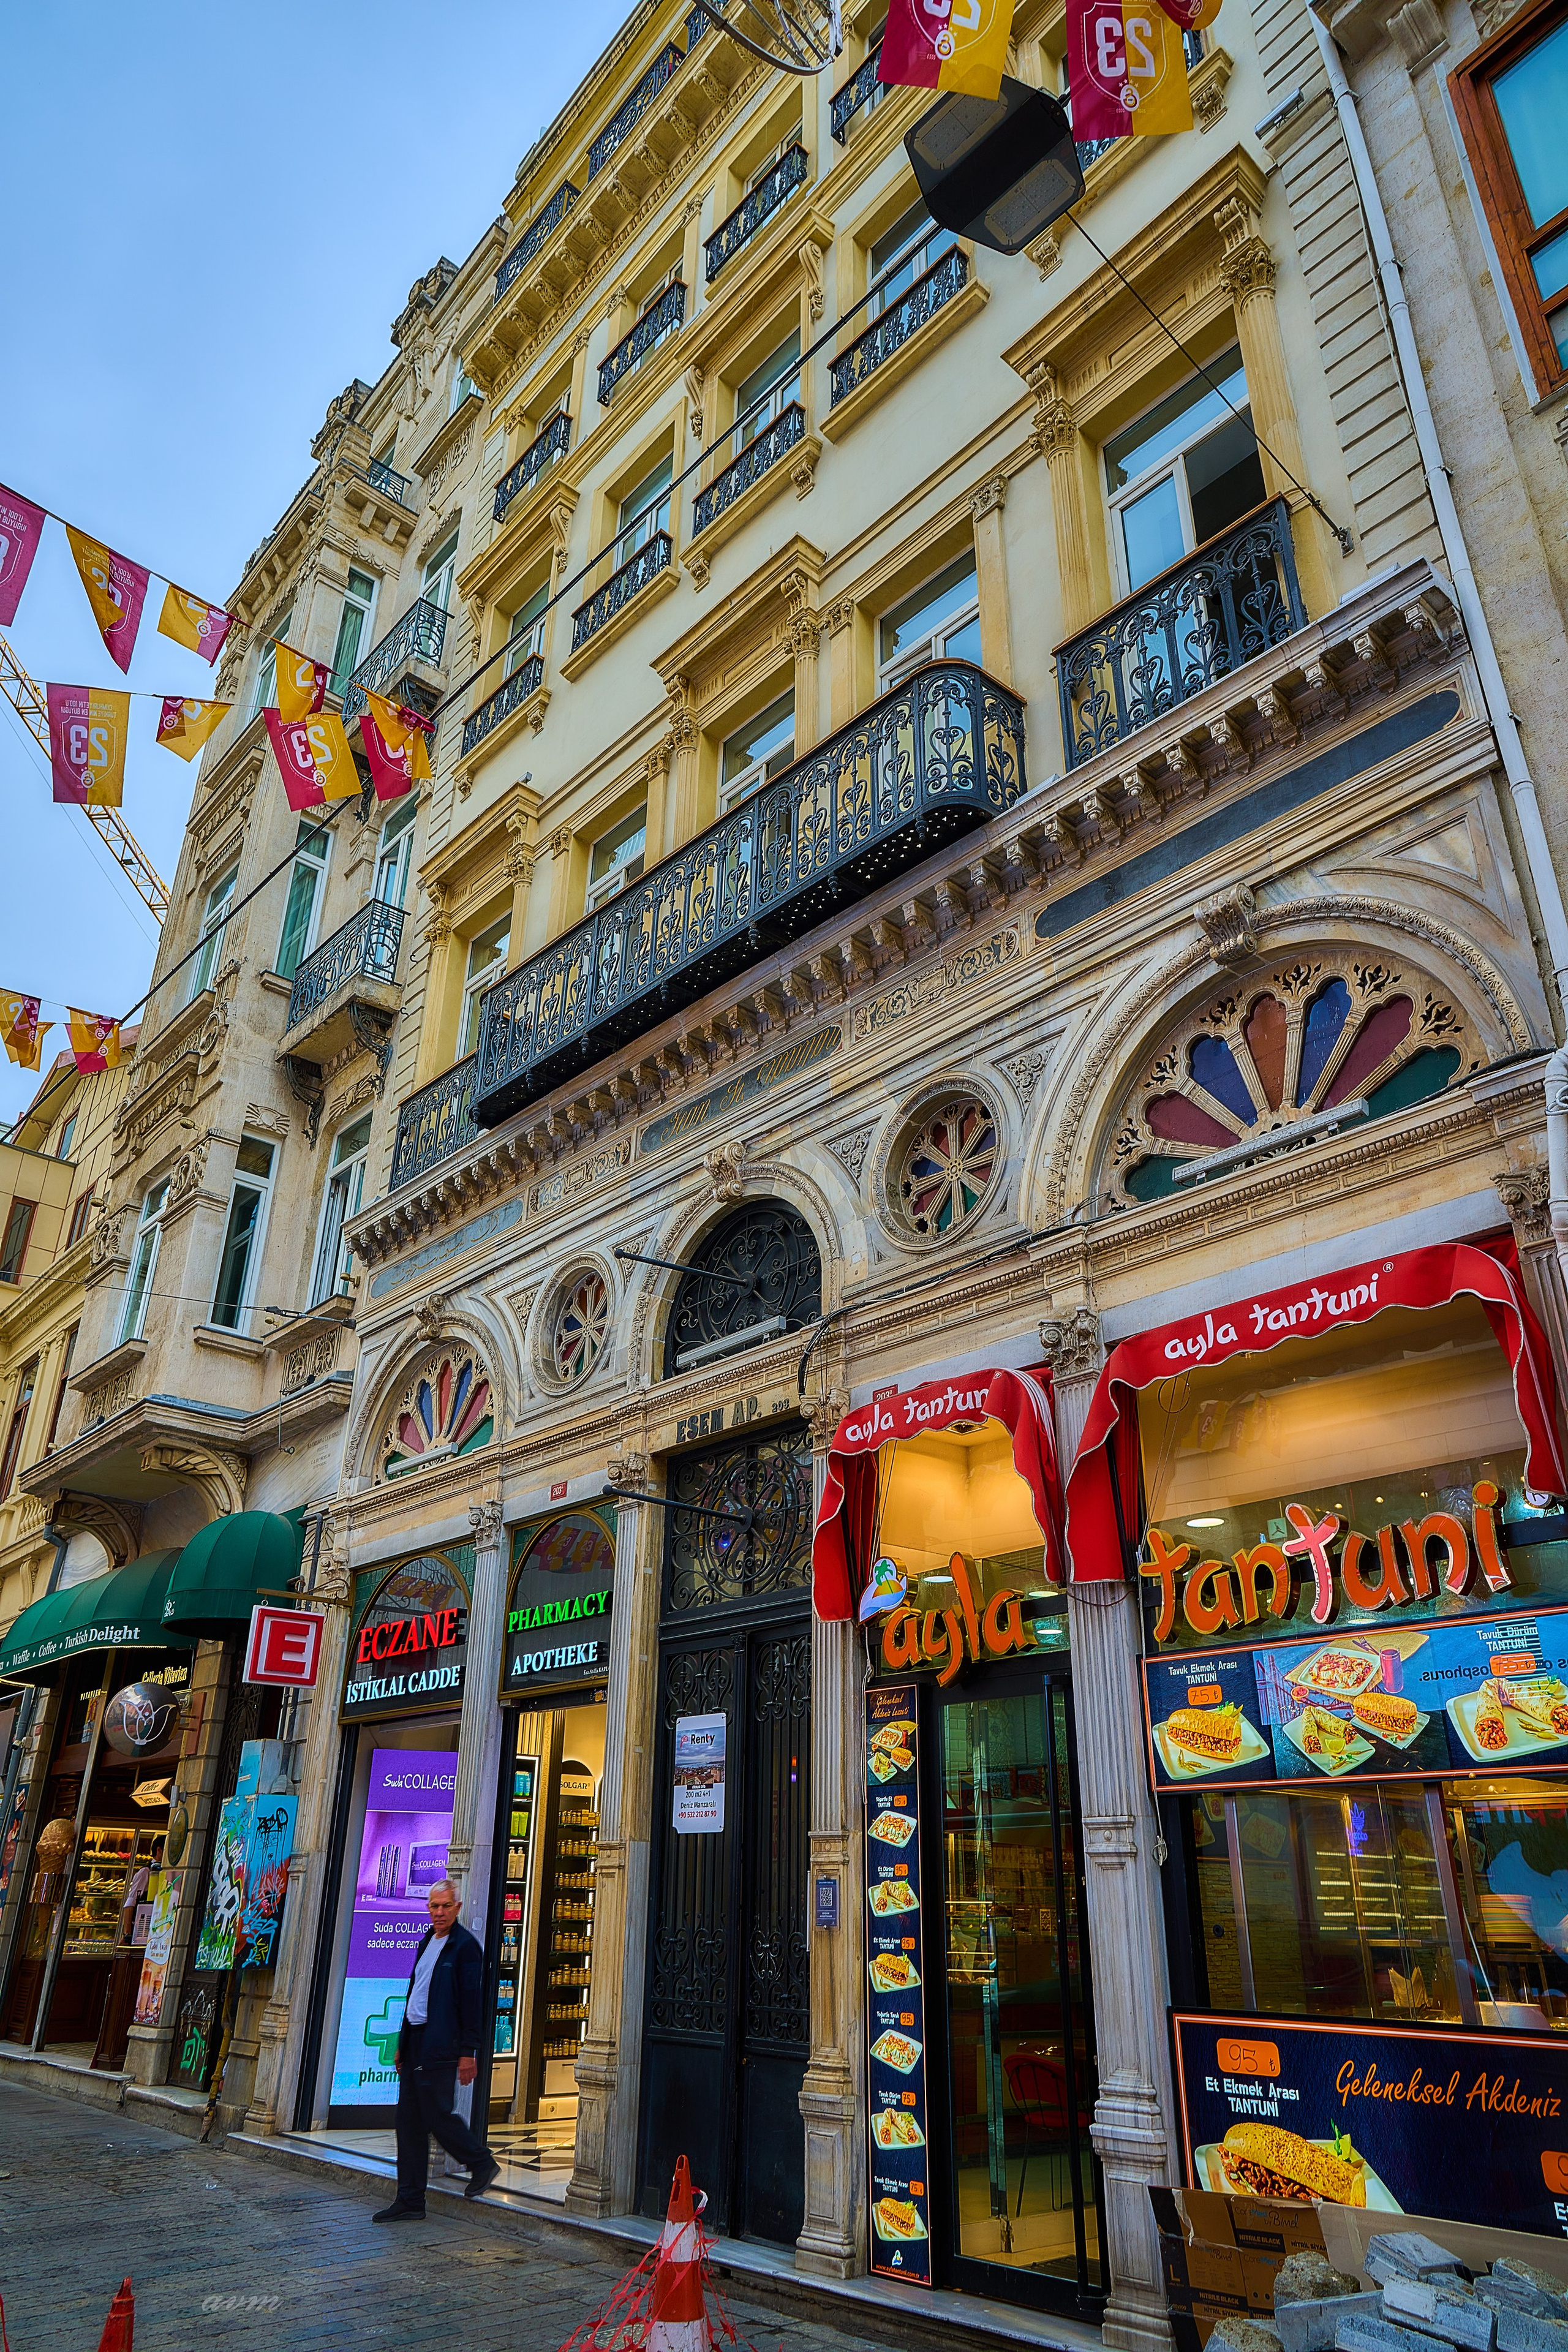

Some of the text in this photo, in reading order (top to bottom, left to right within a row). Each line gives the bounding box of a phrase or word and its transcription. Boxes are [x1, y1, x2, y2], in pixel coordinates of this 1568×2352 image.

[1164, 1273, 1379, 1360] ayla tantuni
[676, 1396, 790, 1443] ESEN AP. 203
[846, 1386, 989, 1443] ayla tantun
[1139, 1480, 1511, 1644] tantuni
[508, 1590, 608, 1633] PHARMACY
[882, 1551, 1024, 1687] ayla
[12, 1649, 30, 1666] Waffle
[39, 1642, 57, 1657] Coffee
[64, 1629, 88, 1649] Turkish
[88, 1625, 141, 1643] Delight
[264, 1620, 310, 1675] E
[356, 1608, 458, 1663] ECZANE
[1476, 1629, 1502, 1640] Tavuk
[511, 1641, 598, 1676] APOTHEKE
[1168, 1660, 1237, 1676] Tavuk Ekmek Arası
[345, 1665, 461, 1704] İSTİKLAL CADDE
[690, 1733, 715, 1746] Renty
[404, 1773, 457, 1790] COLLAGE
[420, 1860, 445, 1868] COLLAGEN
[374, 1922, 393, 1932] Suda
[368, 1938, 420, 1949] sadece eczan
[359, 2067, 401, 2086] pharm
[1205, 2076, 1300, 2100] Et Ekmek Arası
[1336, 2060, 1562, 2119] Geleneksel Akdeniz
[1227, 2097, 1279, 2117] TANTUNİ
[1169, 2264, 1181, 2282] L
[1221, 2296, 1239, 2305] BLACK
